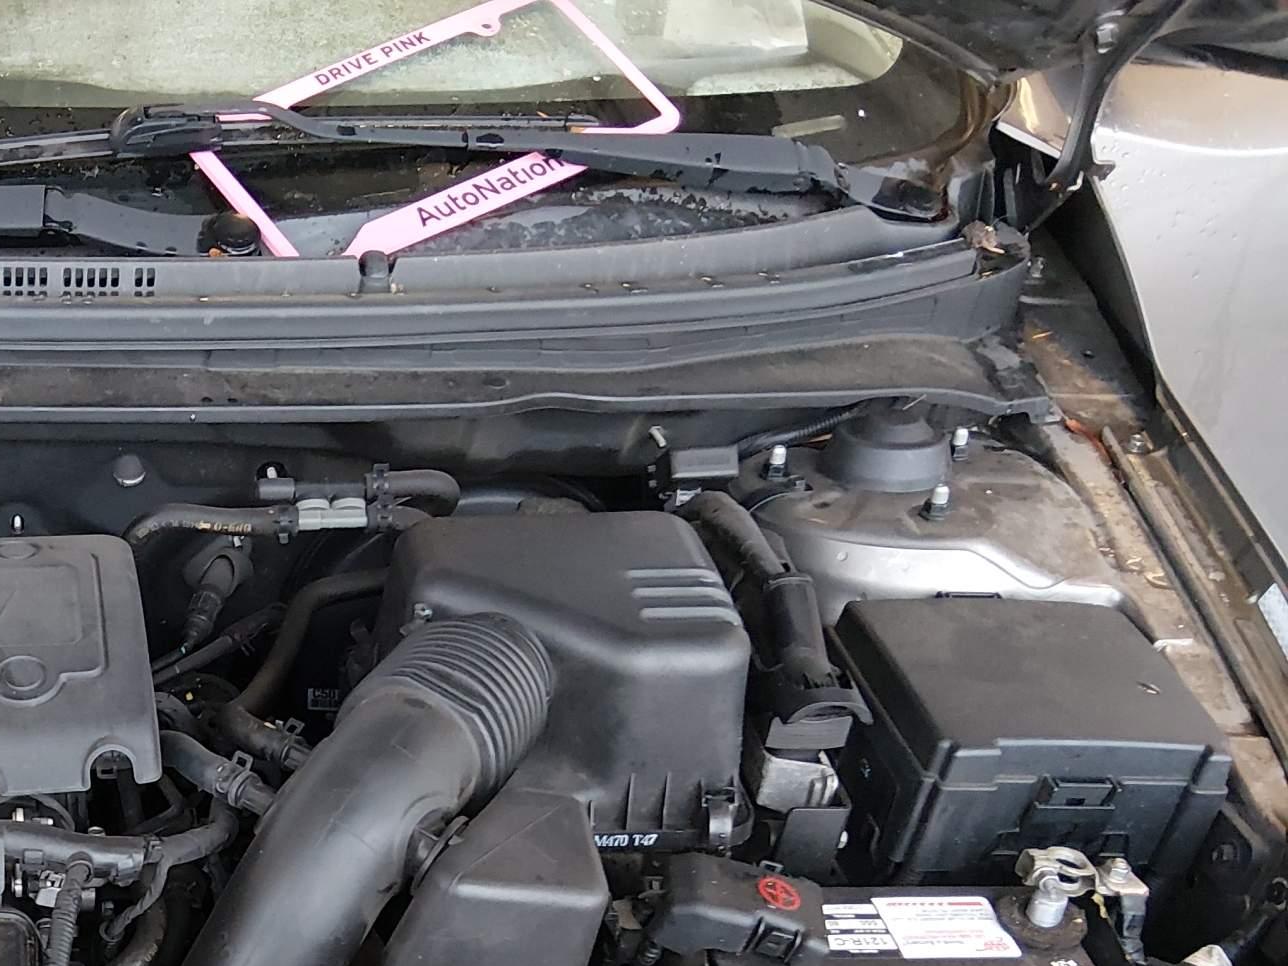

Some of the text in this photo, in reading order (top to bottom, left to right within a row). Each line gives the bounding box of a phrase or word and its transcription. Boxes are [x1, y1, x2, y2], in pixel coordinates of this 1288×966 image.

[314, 31, 431, 86] DRIVE PINK
[416, 155, 565, 228] AutoNation
[834, 936, 889, 947] 121R-C
